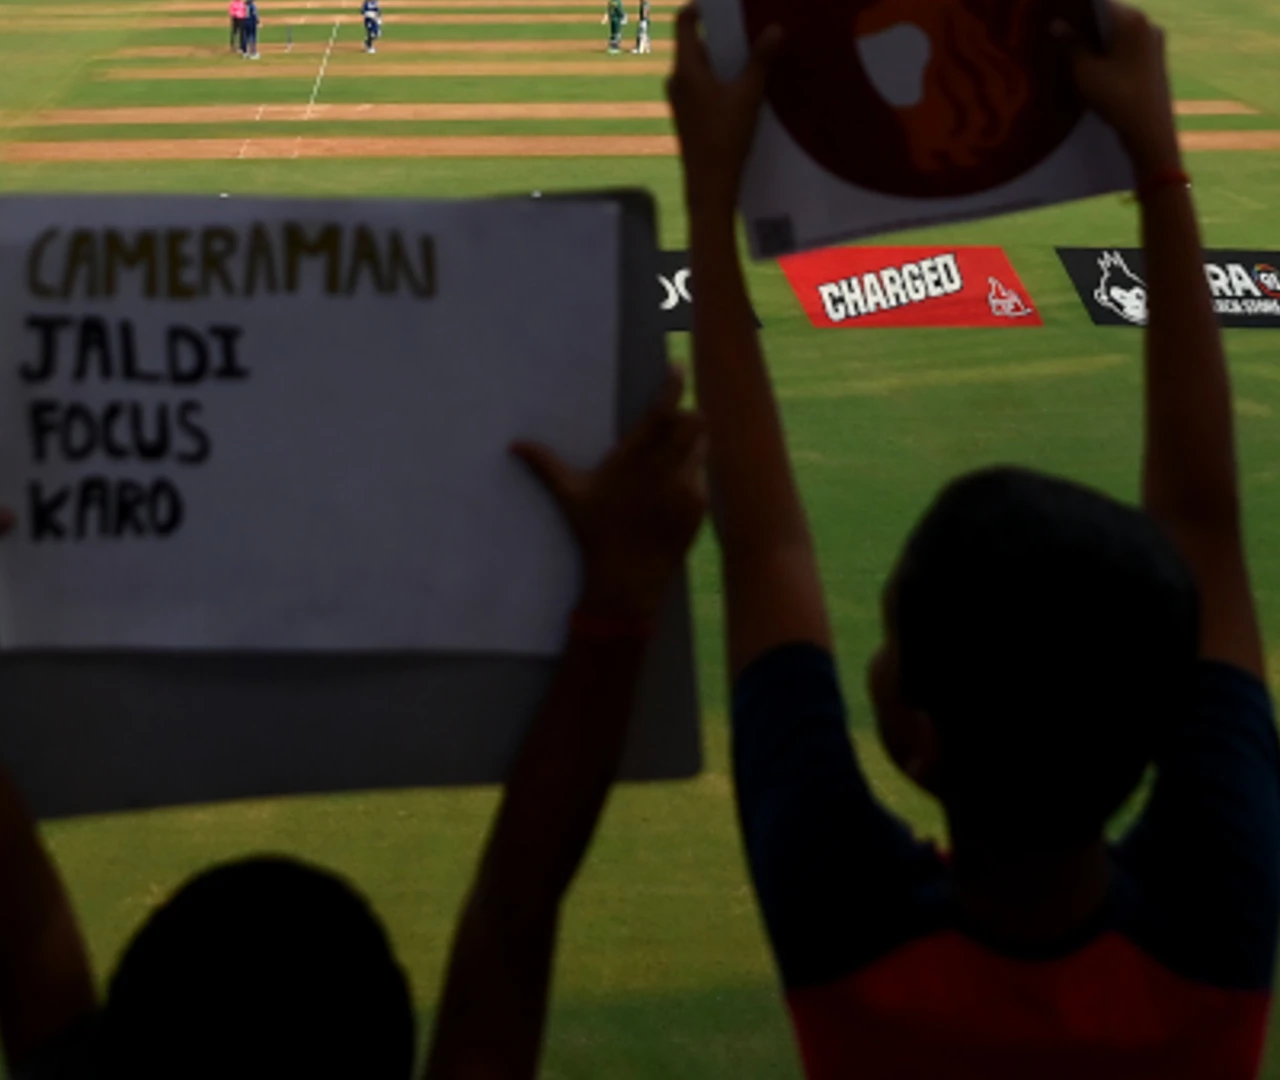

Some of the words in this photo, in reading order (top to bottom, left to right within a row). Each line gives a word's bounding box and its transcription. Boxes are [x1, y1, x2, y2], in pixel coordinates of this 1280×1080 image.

[26, 220, 438, 301] CAMERAMAN
[818, 253, 964, 323] CHARGED
[19, 314, 249, 386] JALDI
[29, 397, 212, 466] FOCUS
[28, 475, 185, 543] KARO
